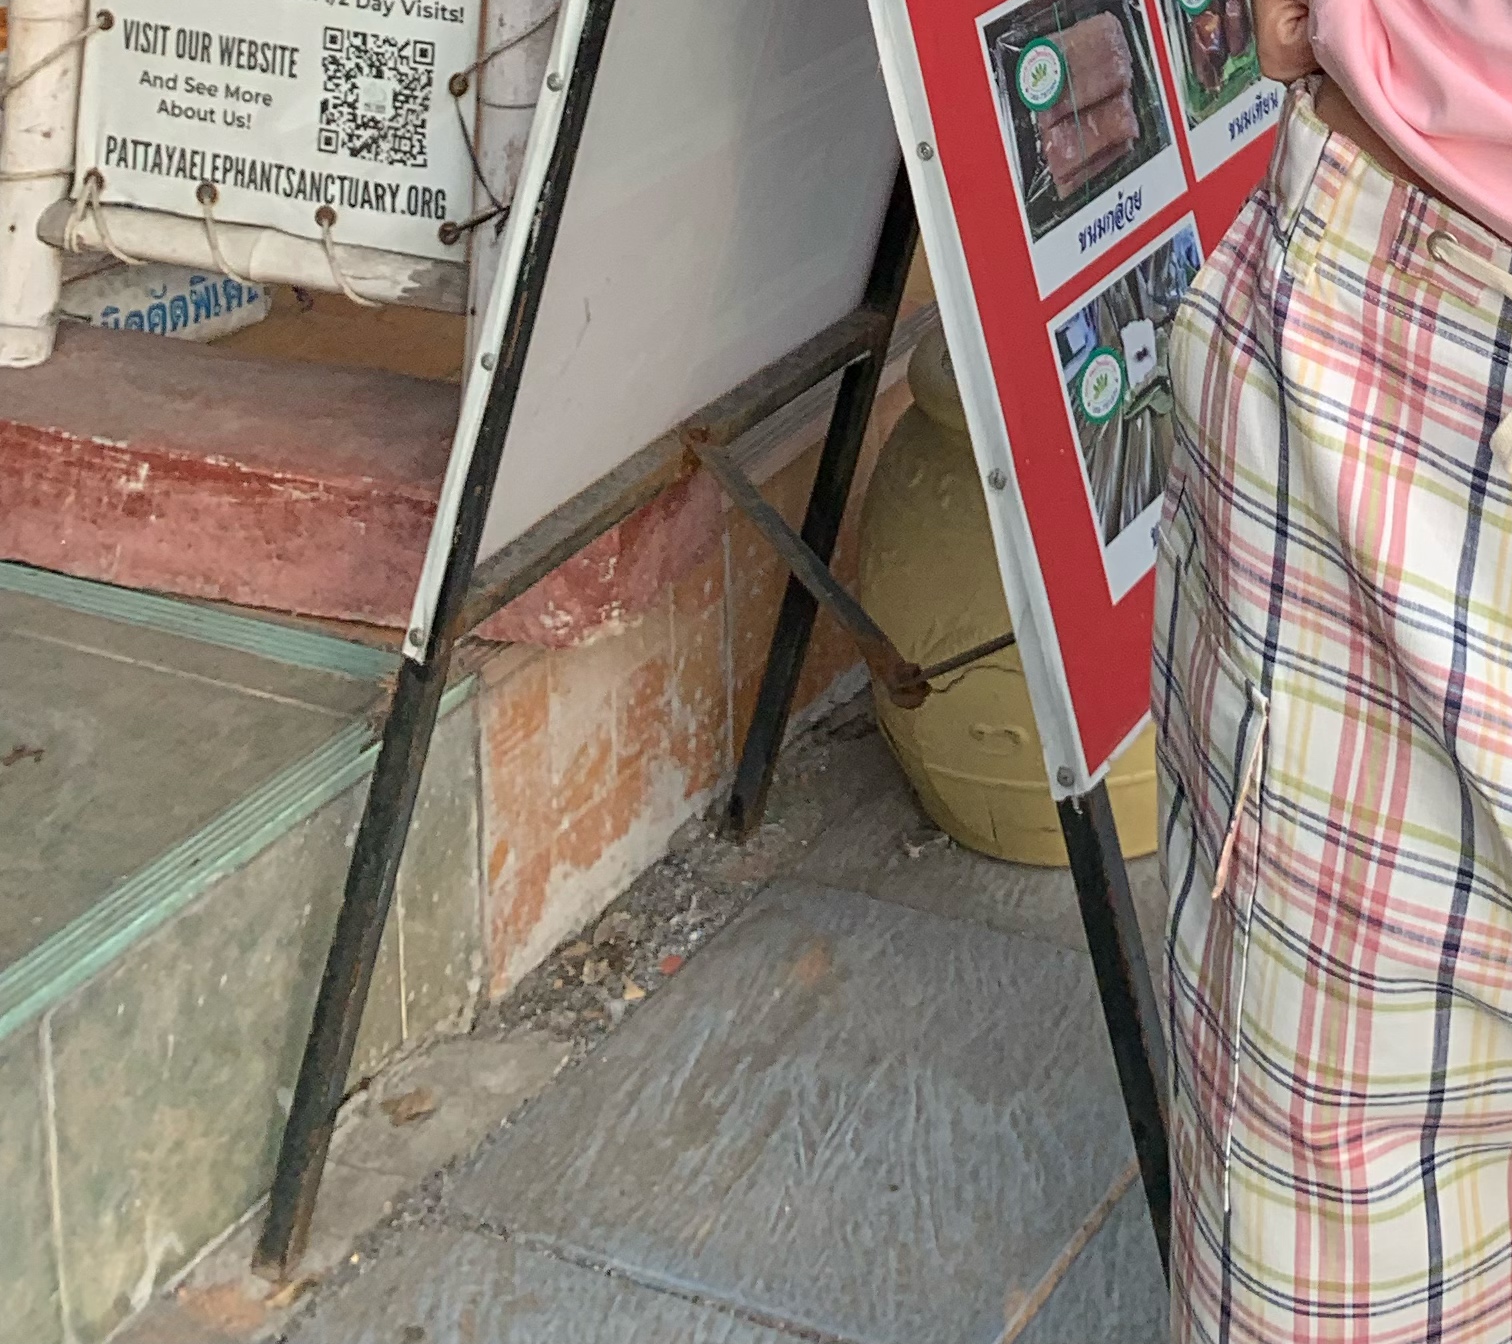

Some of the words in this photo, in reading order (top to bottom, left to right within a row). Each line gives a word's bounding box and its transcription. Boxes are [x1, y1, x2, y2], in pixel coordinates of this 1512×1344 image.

[122, 18, 171, 56] VISIT
[175, 27, 213, 64] OUR
[219, 34, 301, 79] WEBSITE
[139, 69, 178, 93] And
[184, 75, 218, 98] See
[224, 83, 274, 108] More
[156, 98, 216, 125] About
[222, 106, 253, 130] Us!
[105, 134, 447, 221] PATTAYAELEPHANTSANCTUARY.ORG
[1078, 184, 1143, 254] ขนมกล้วย
